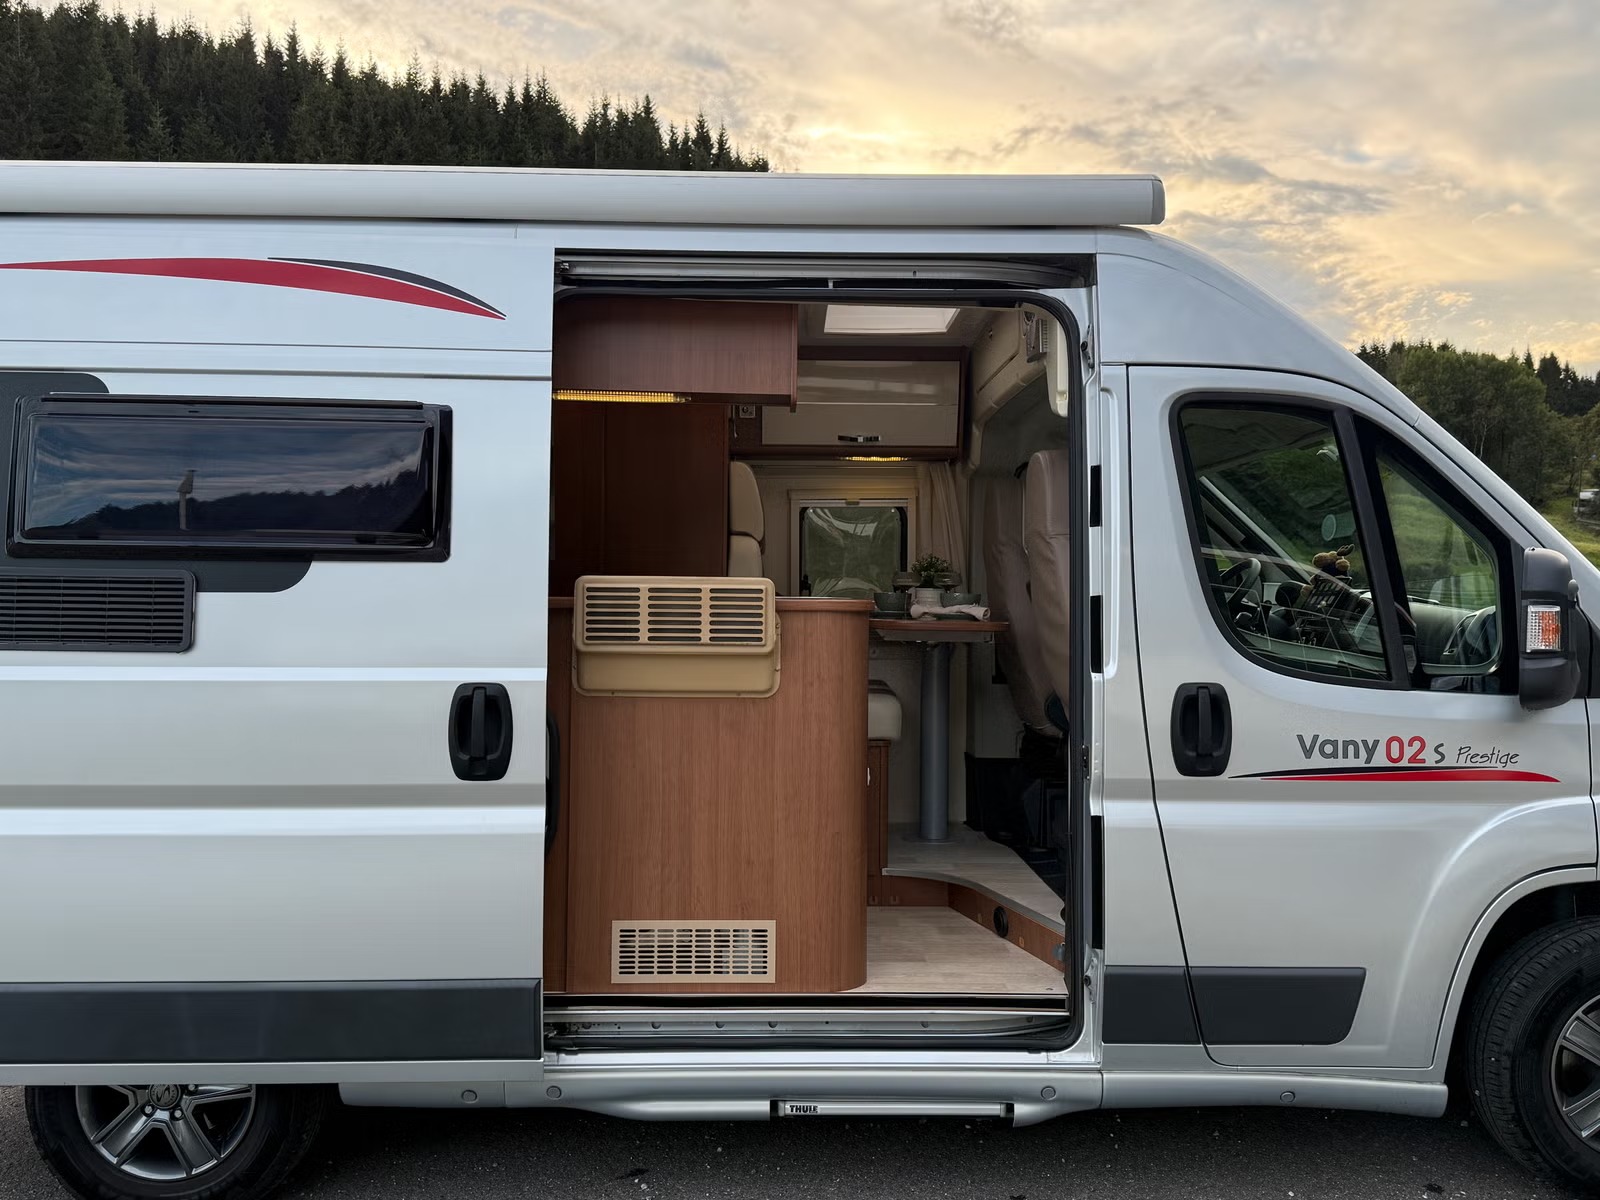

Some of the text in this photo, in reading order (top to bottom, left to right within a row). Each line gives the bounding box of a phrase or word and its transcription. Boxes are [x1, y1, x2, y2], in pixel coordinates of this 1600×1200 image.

[1296, 734, 1380, 764] Vany
[1456, 746, 1520, 768] Prestige
[789, 1104, 819, 1114] THULE
